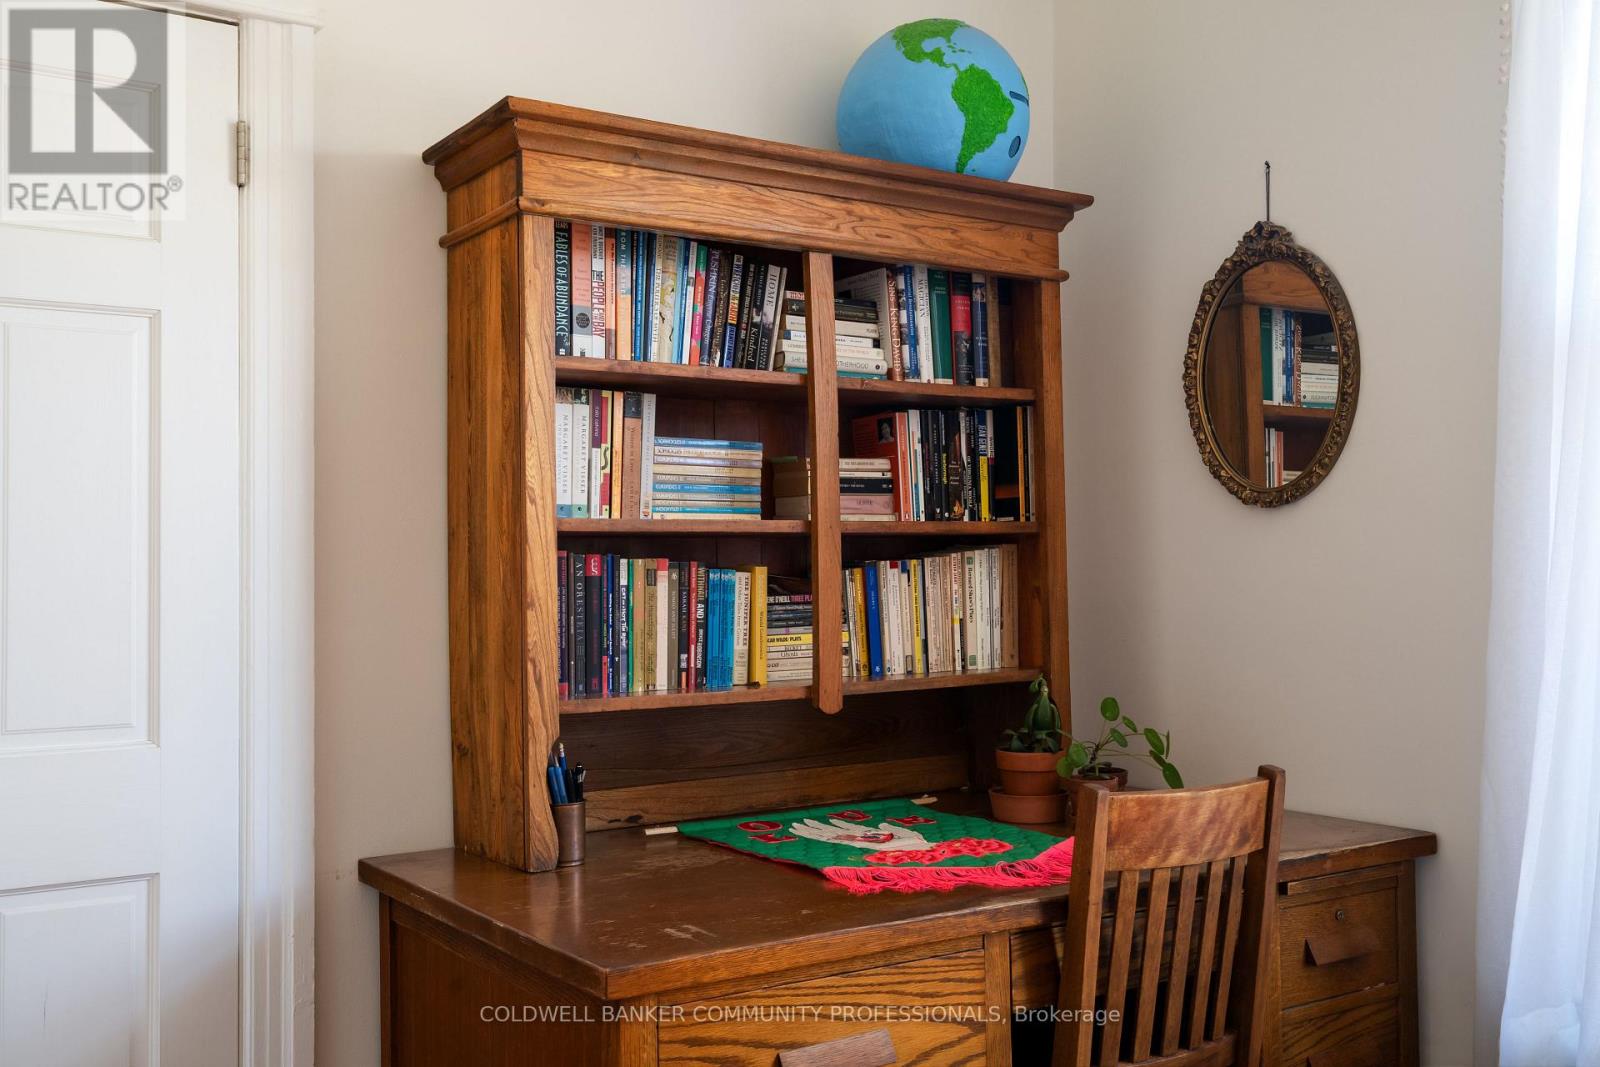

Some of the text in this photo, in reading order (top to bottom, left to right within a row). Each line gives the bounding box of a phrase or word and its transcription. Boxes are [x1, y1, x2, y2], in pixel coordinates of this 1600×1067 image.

[556, 231, 569, 337] FABLES OF ABUNDANCE
[708, 250, 720, 293] PUSHKIN
[592, 281, 605, 312] PEOPLE
[766, 273, 777, 307] HOME
[593, 321, 605, 338] BAY
[888, 280, 901, 371] SINS KING DAVID
[747, 327, 758, 362] Kindred
[978, 425, 987, 455] JEAN GENET
[576, 562, 585, 641] AN ORESTEIA
[697, 567, 705, 602] WITHNAIL
[697, 603, 705, 619] AND
